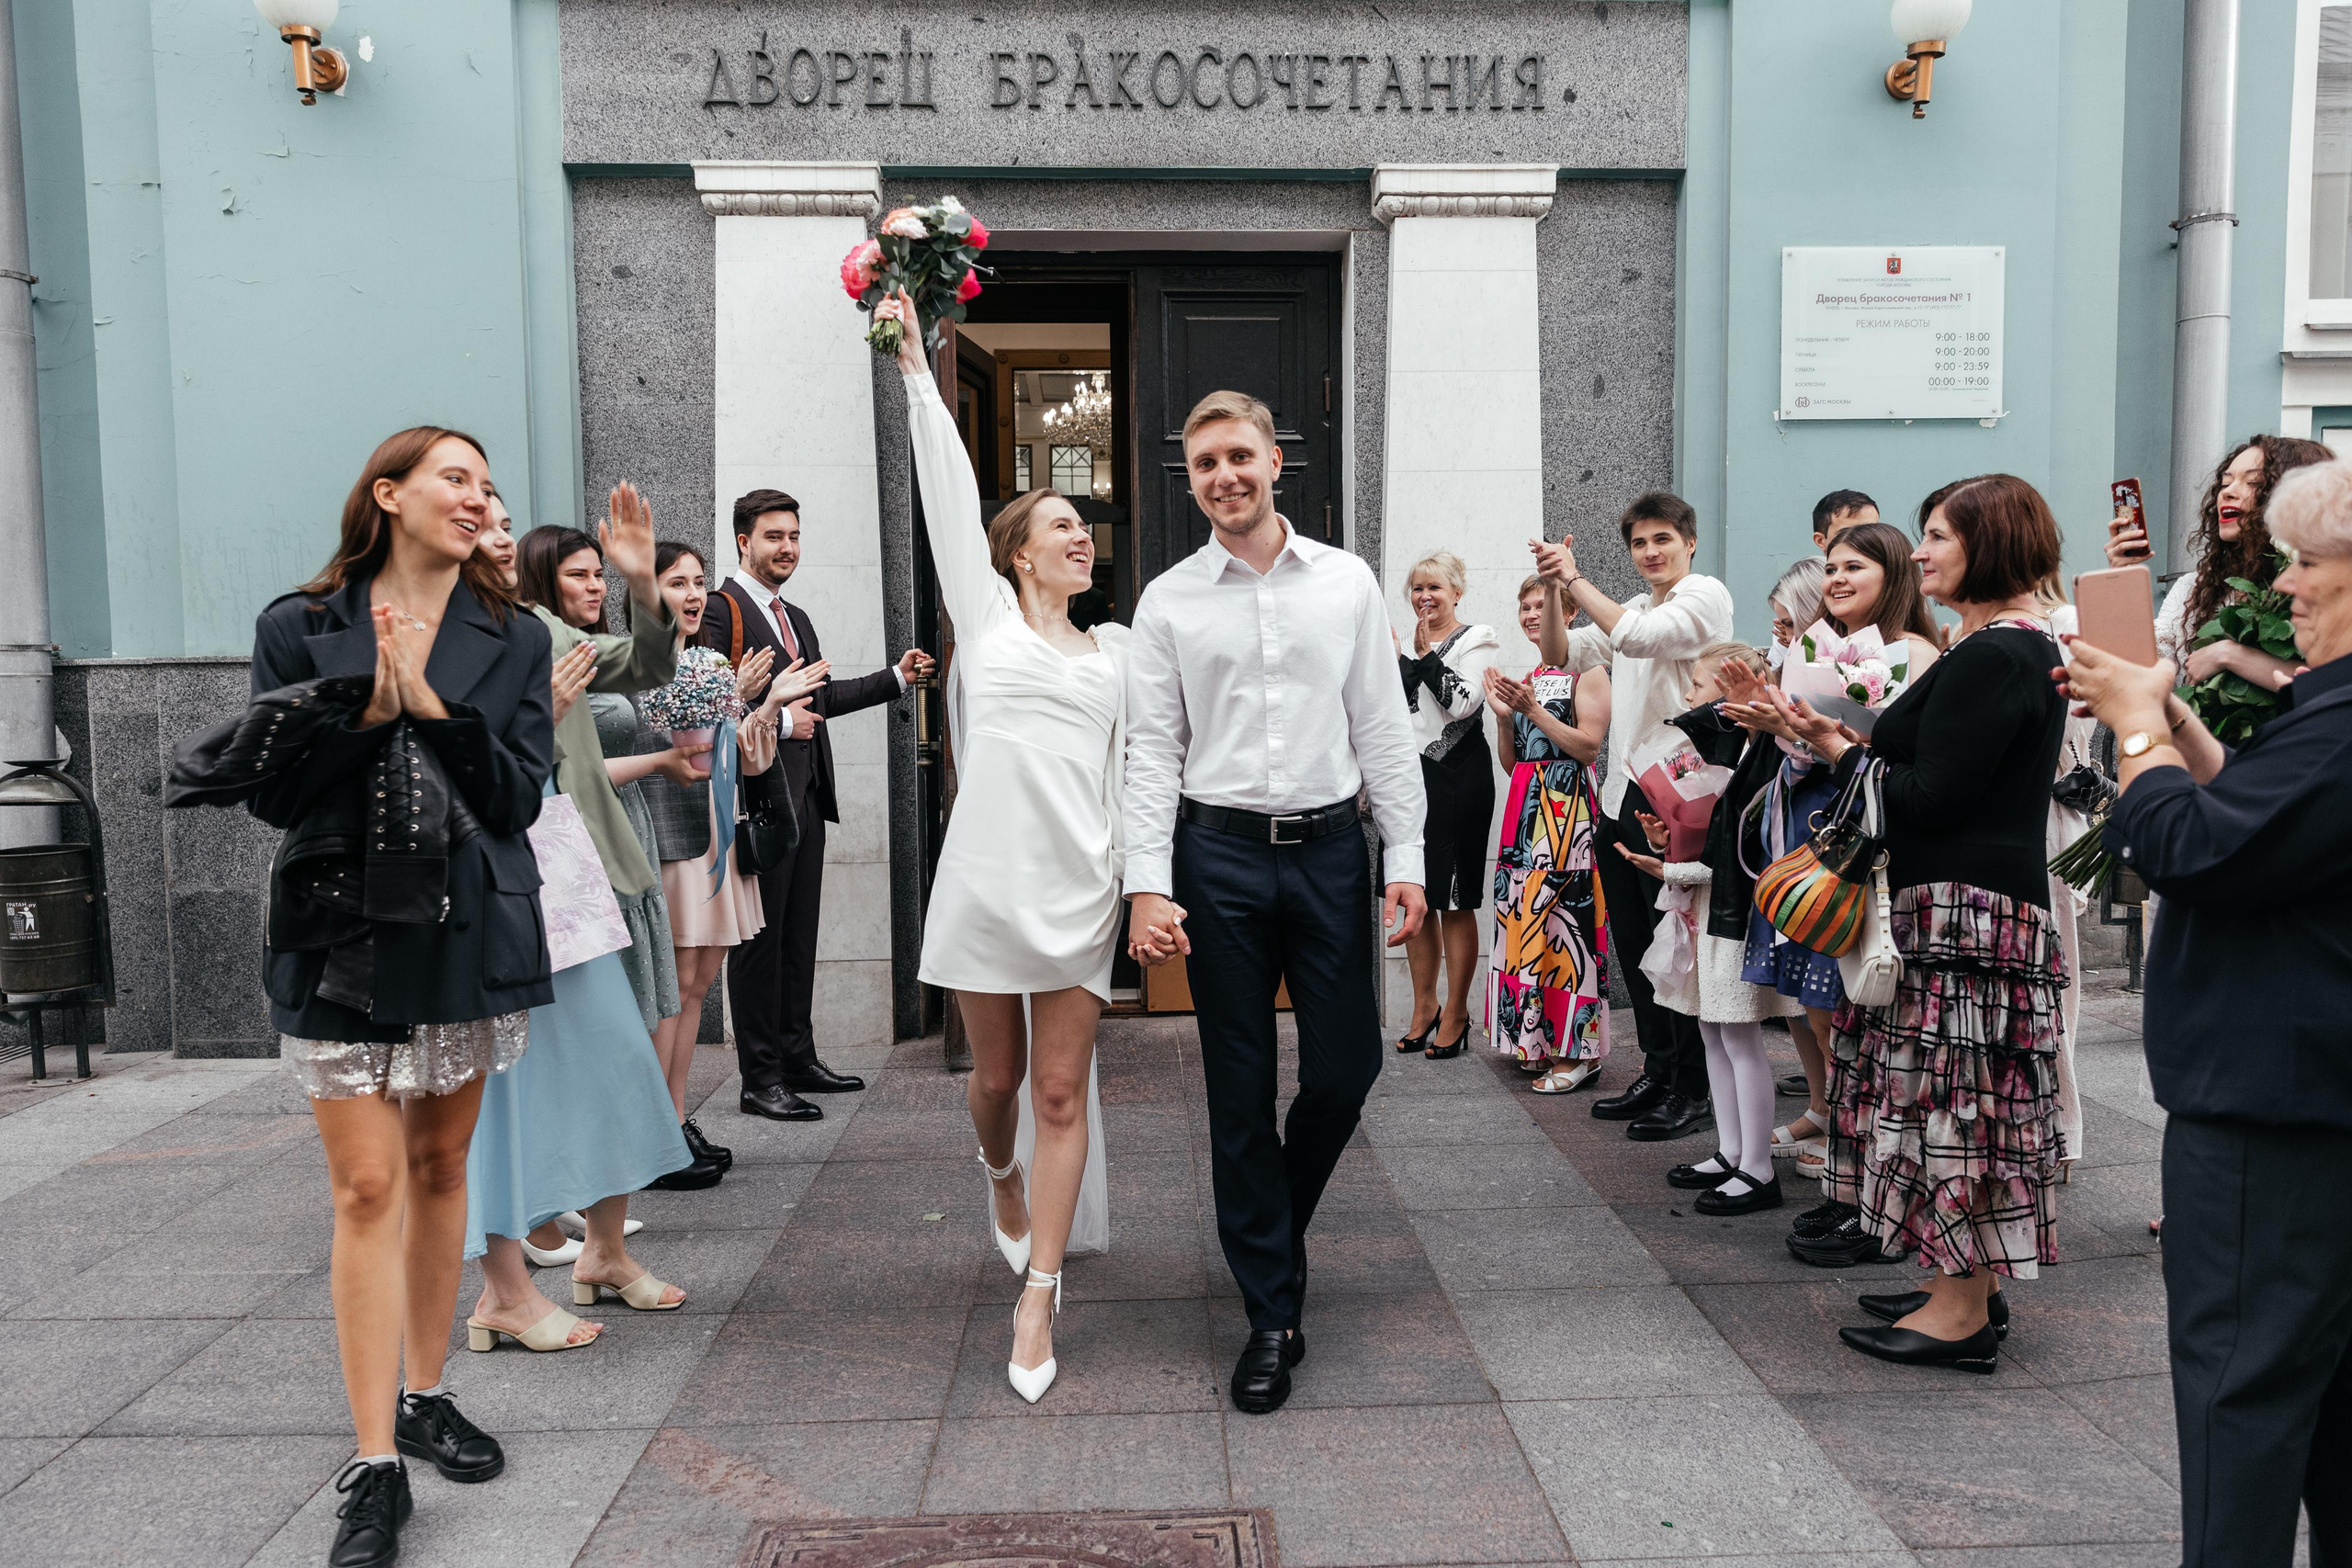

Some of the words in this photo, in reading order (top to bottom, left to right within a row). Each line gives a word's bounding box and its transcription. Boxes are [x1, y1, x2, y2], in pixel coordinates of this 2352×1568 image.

[703, 46, 937, 113] ДВОРЕЦ
[990, 49, 1545, 111] БРАКОСОЧЕТАНИЯ
[1815, 293, 1857, 305] Дворец
[1860, 292, 1947, 305] бракосочетания
[1950, 292, 1963, 302] №
[1966, 292, 1971, 302] 1
[1856, 319, 1891, 328] РЕЖИМ
[1894, 319, 1930, 328] РАБОТЫ
[1935, 333, 1956, 342] 9:00
[1966, 332, 1990, 342] 18:00
[1935, 347, 1956, 356] 9:00
[1963, 346, 1990, 356] 20:00
[1935, 362, 1956, 371] 9:00
[1963, 361, 1990, 371] 23:59
[1928, 377, 1956, 386] 00:00
[1964, 377, 1989, 386] 19:00
[1534, 687, 1569, 697] ETLUS
